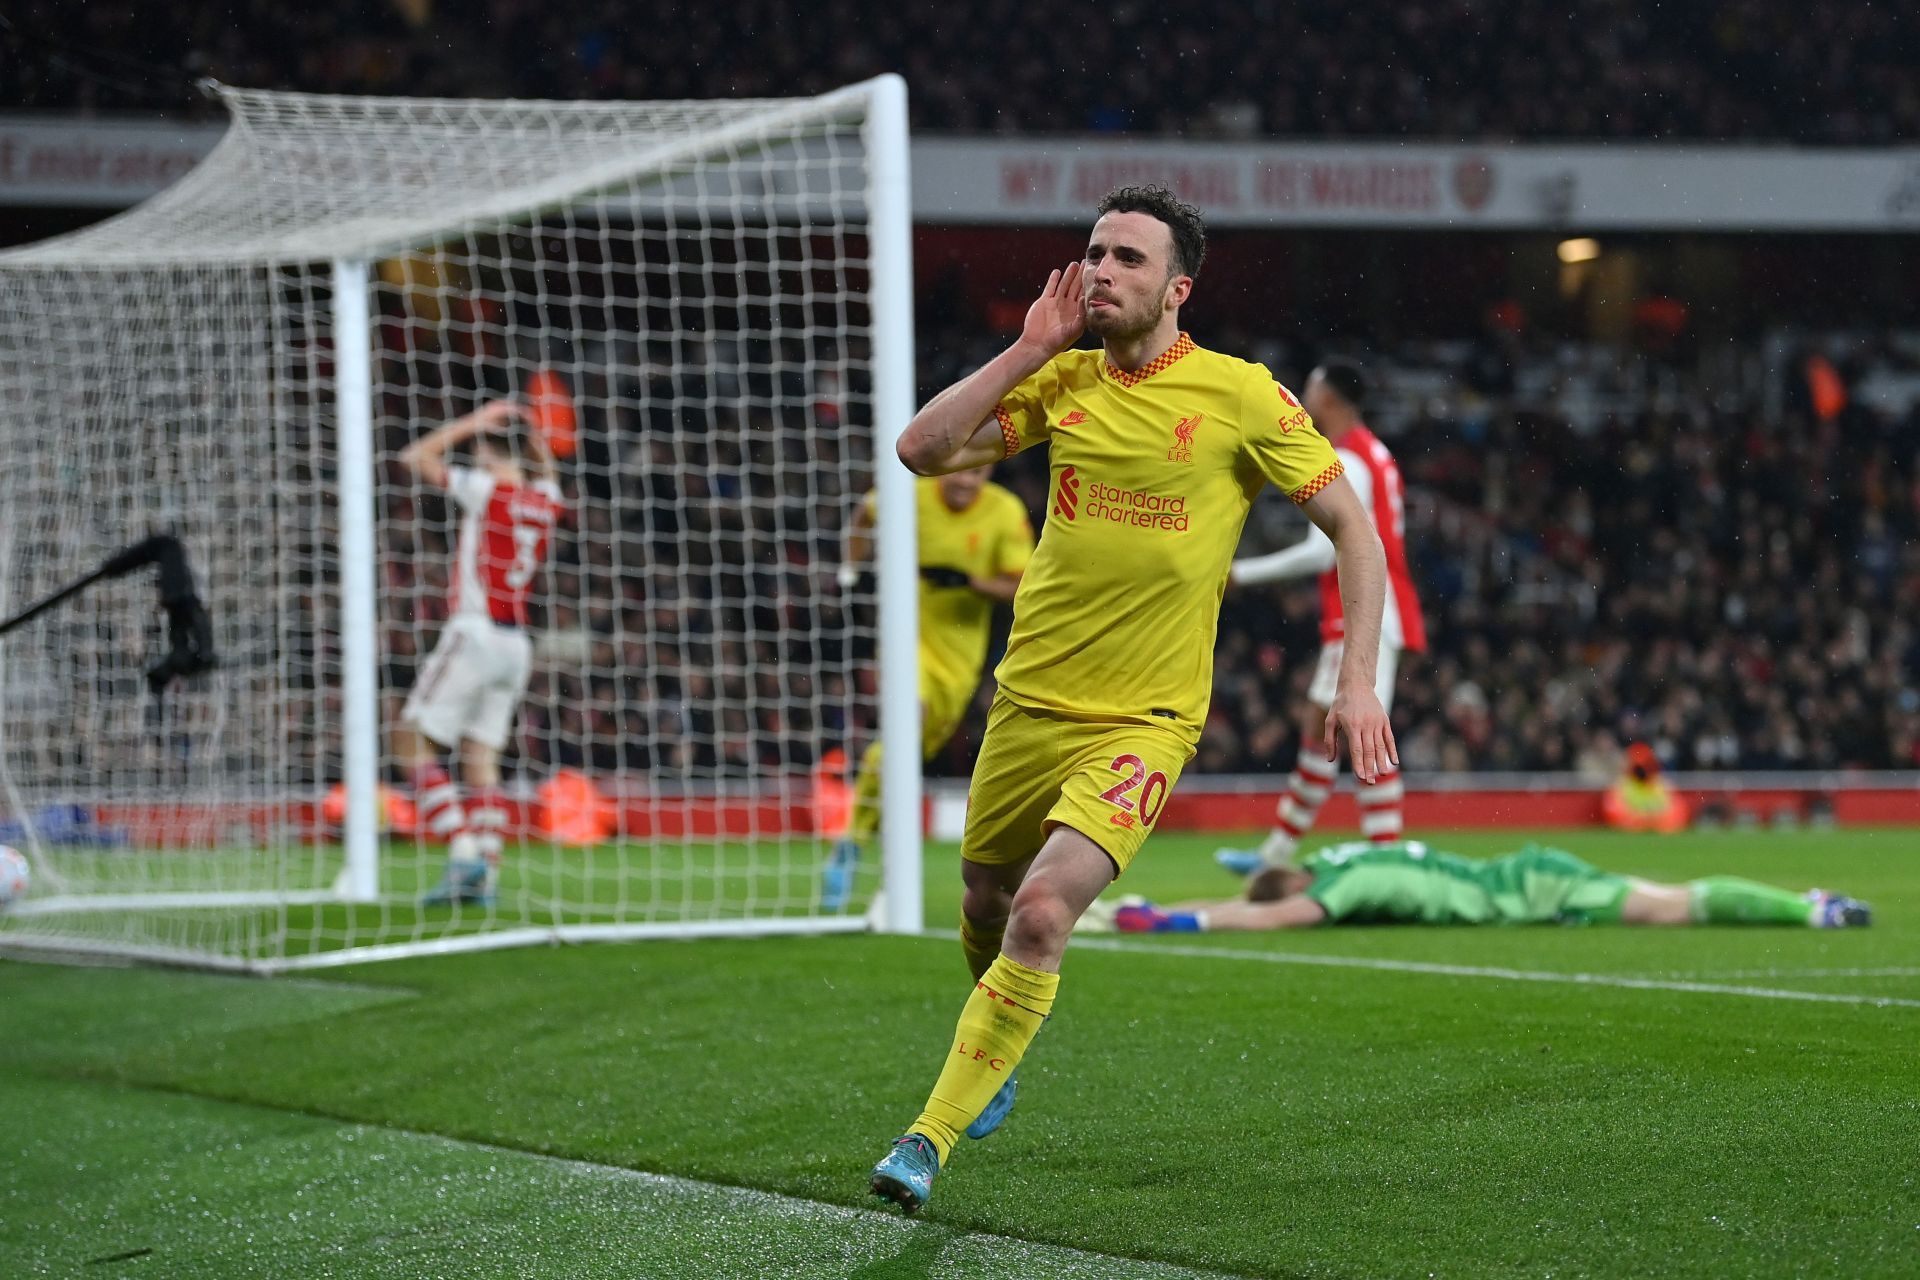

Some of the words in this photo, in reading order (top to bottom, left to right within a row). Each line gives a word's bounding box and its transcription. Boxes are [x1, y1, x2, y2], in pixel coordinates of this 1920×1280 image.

[1167, 450, 1192, 463] LFC
[1088, 482, 1185, 513] standard
[1086, 501, 1189, 531] chartered
[1098, 753, 1168, 827] 20
